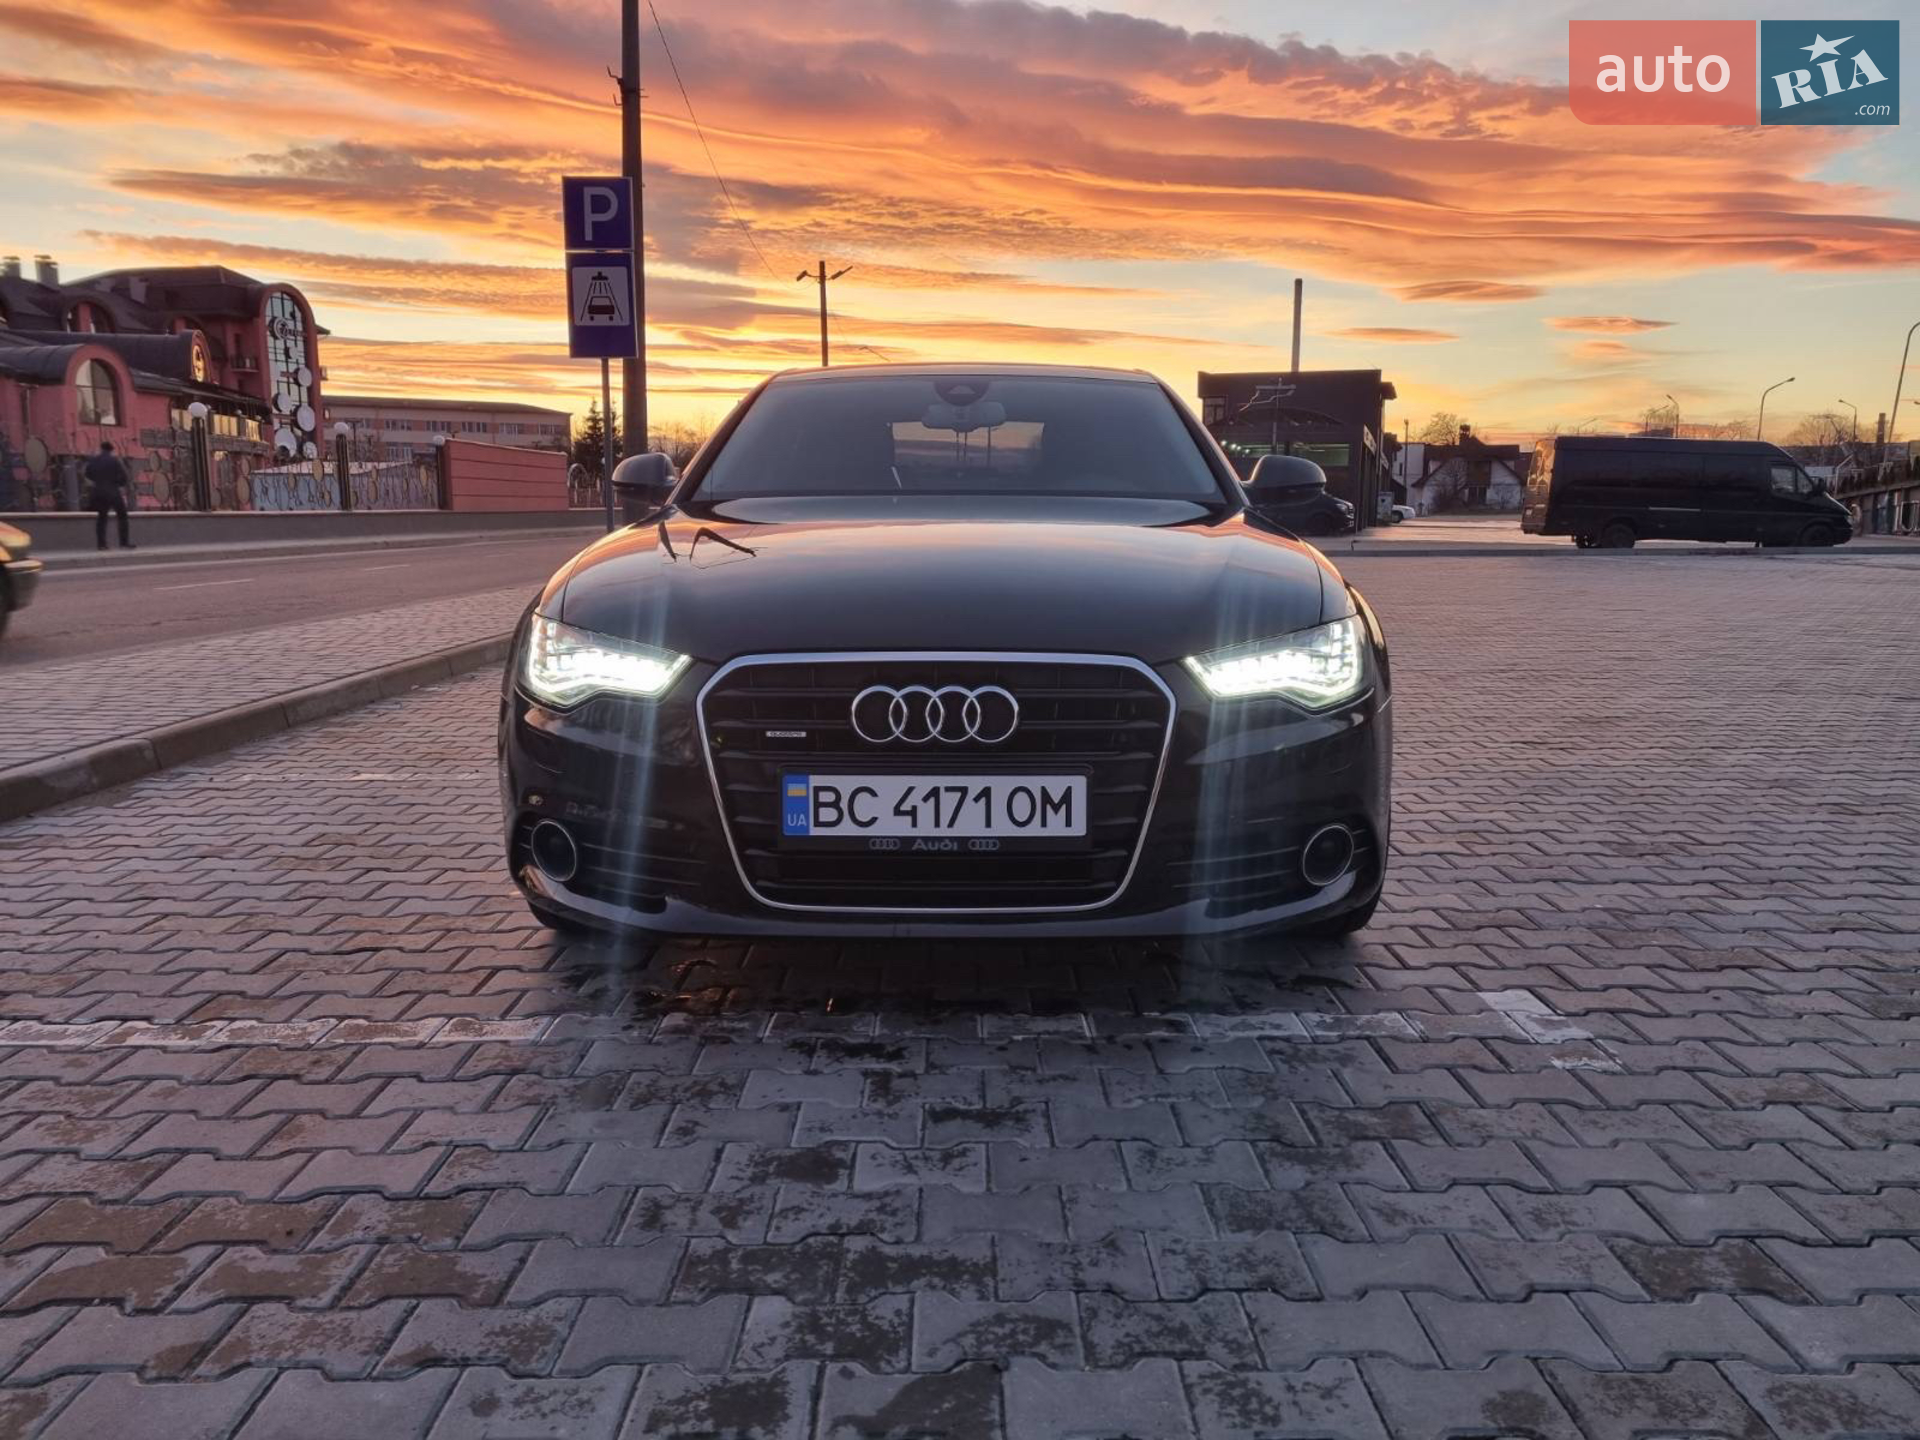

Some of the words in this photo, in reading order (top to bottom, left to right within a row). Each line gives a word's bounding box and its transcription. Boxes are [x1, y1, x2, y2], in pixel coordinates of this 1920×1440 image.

[583, 187, 618, 241] P
[788, 813, 807, 827] UA
[813, 785, 879, 829] BC
[893, 785, 992, 829] 4171
[1006, 785, 1073, 829] OM
[912, 837, 958, 851] Audi
